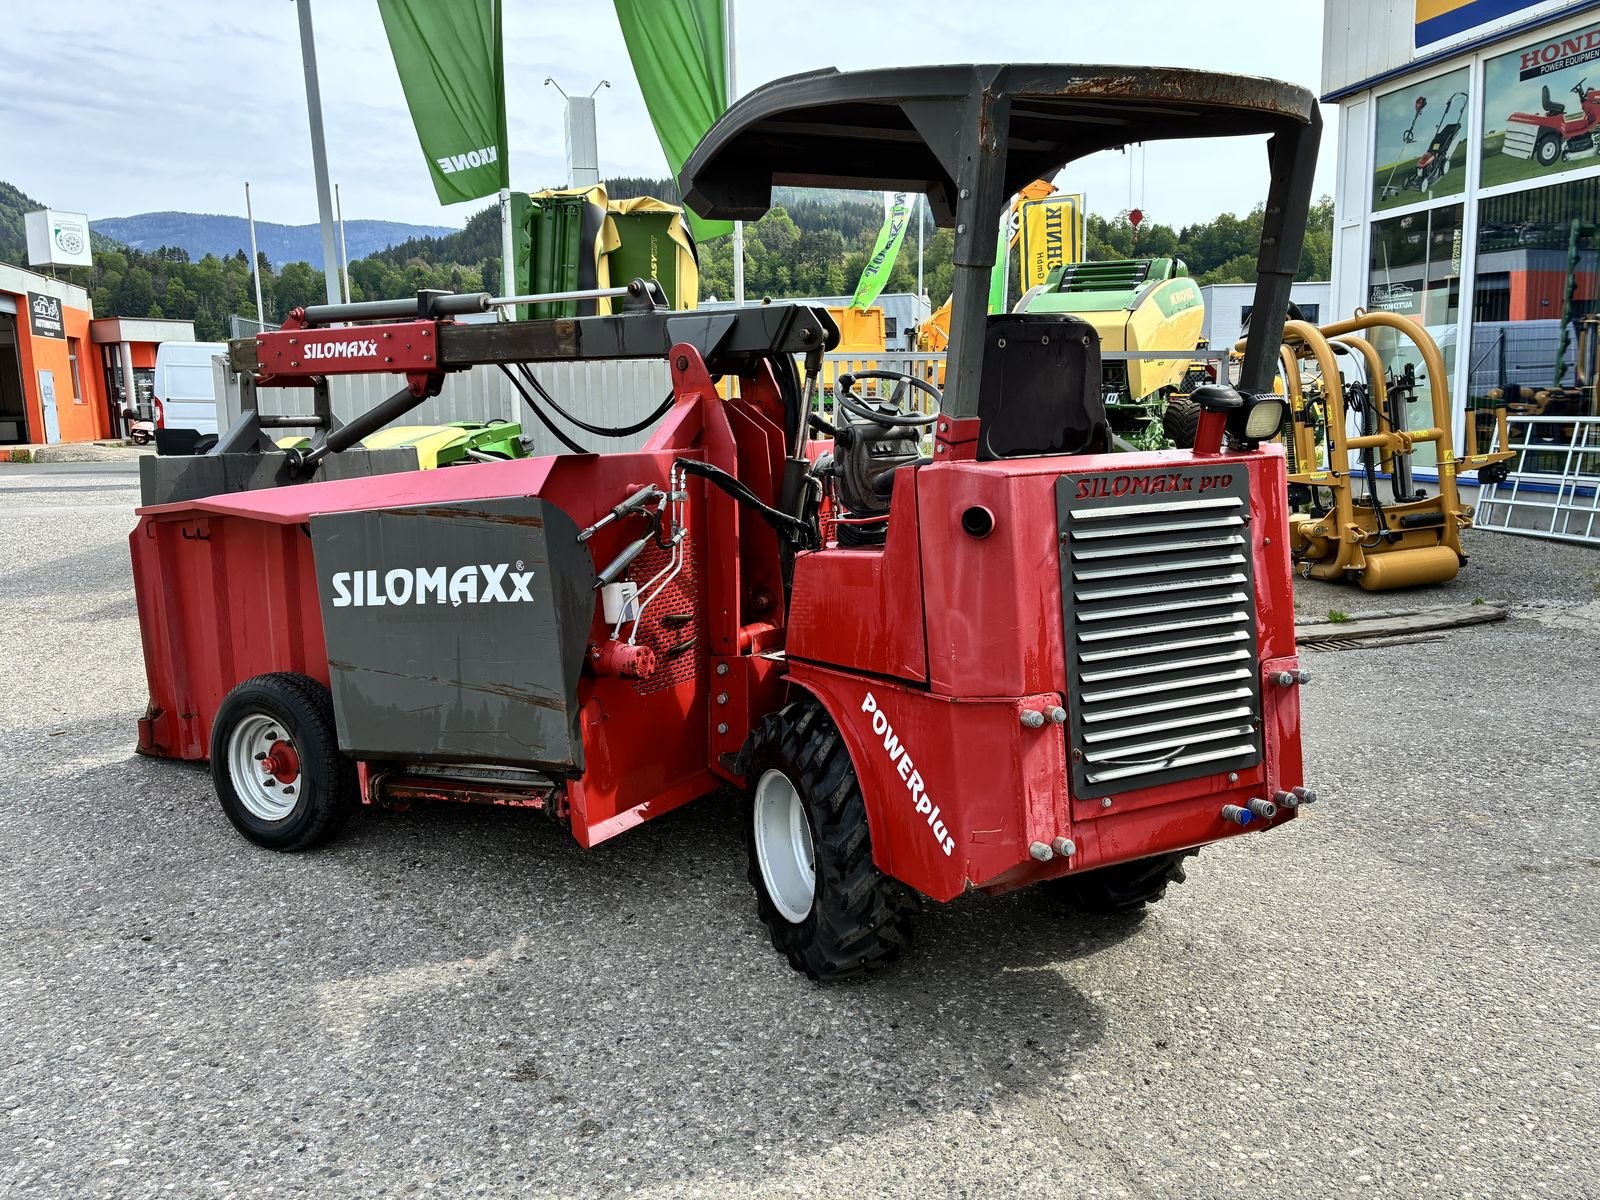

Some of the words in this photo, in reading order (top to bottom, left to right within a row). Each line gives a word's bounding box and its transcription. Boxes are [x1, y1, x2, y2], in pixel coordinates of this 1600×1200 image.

[1541, 60, 1563, 74] POWER
[1199, 474, 1233, 493] pro
[861, 692, 955, 856] POWERplus
